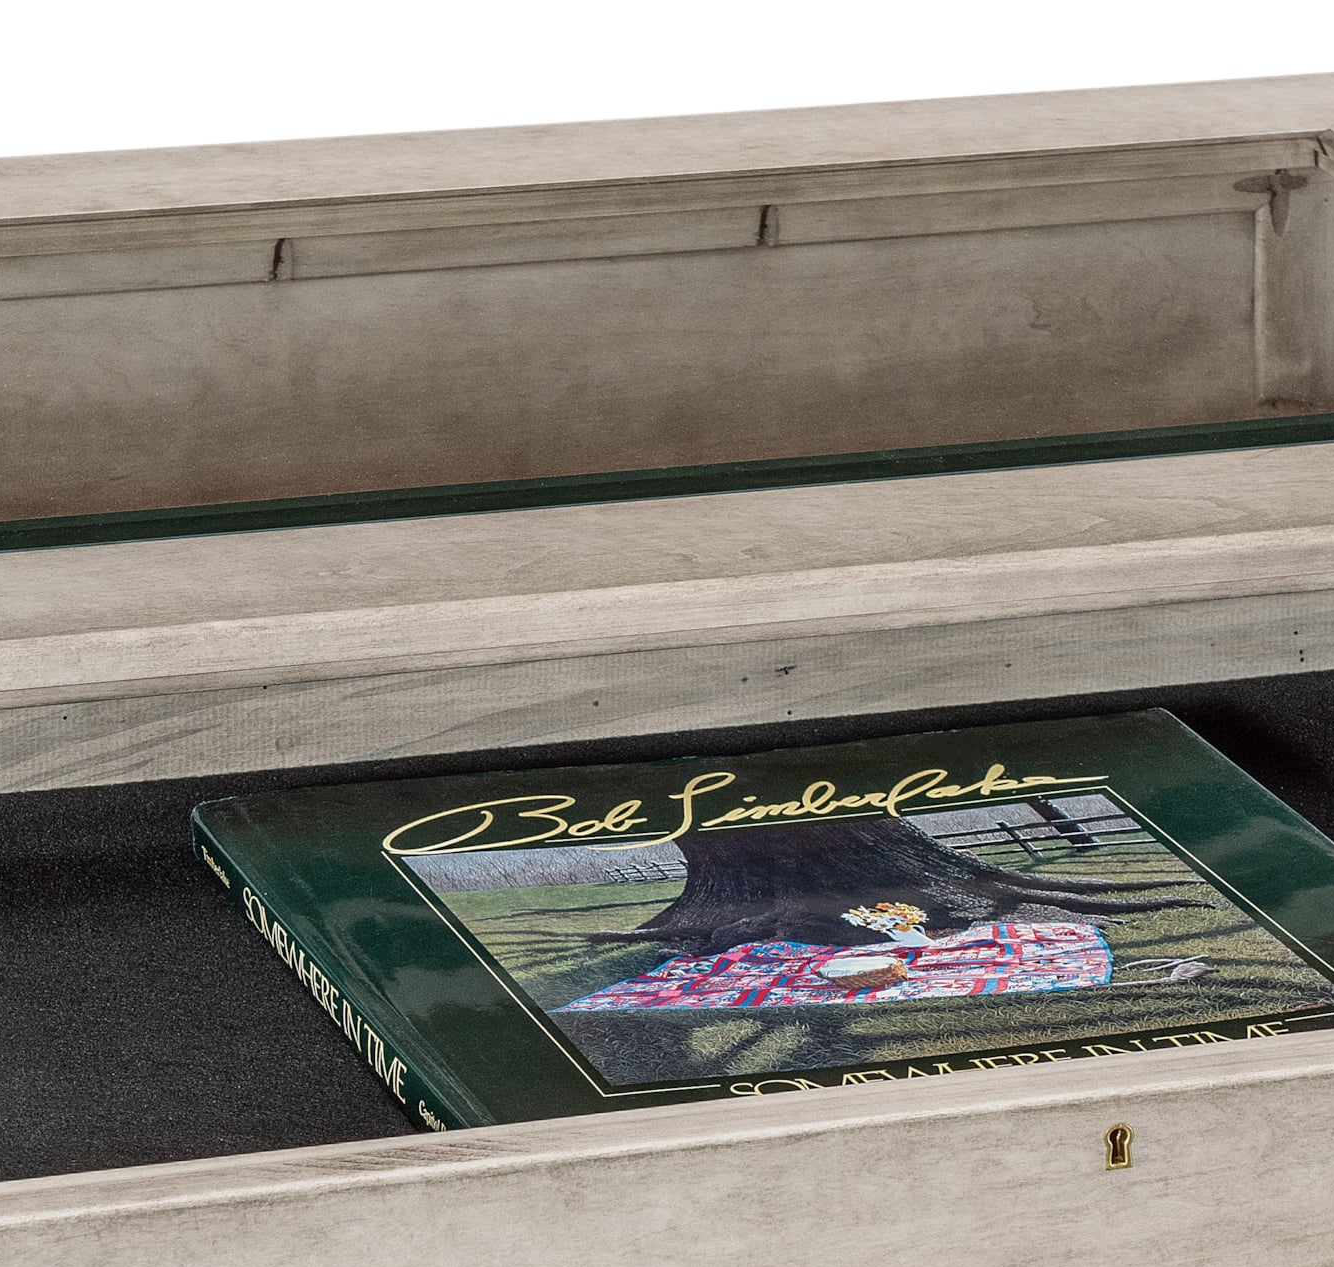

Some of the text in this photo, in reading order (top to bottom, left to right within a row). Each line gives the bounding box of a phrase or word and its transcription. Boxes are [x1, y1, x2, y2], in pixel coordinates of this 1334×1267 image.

[382, 794, 648, 856] Bob
[243, 887, 407, 1104] SOMEWHERE IN TIME
